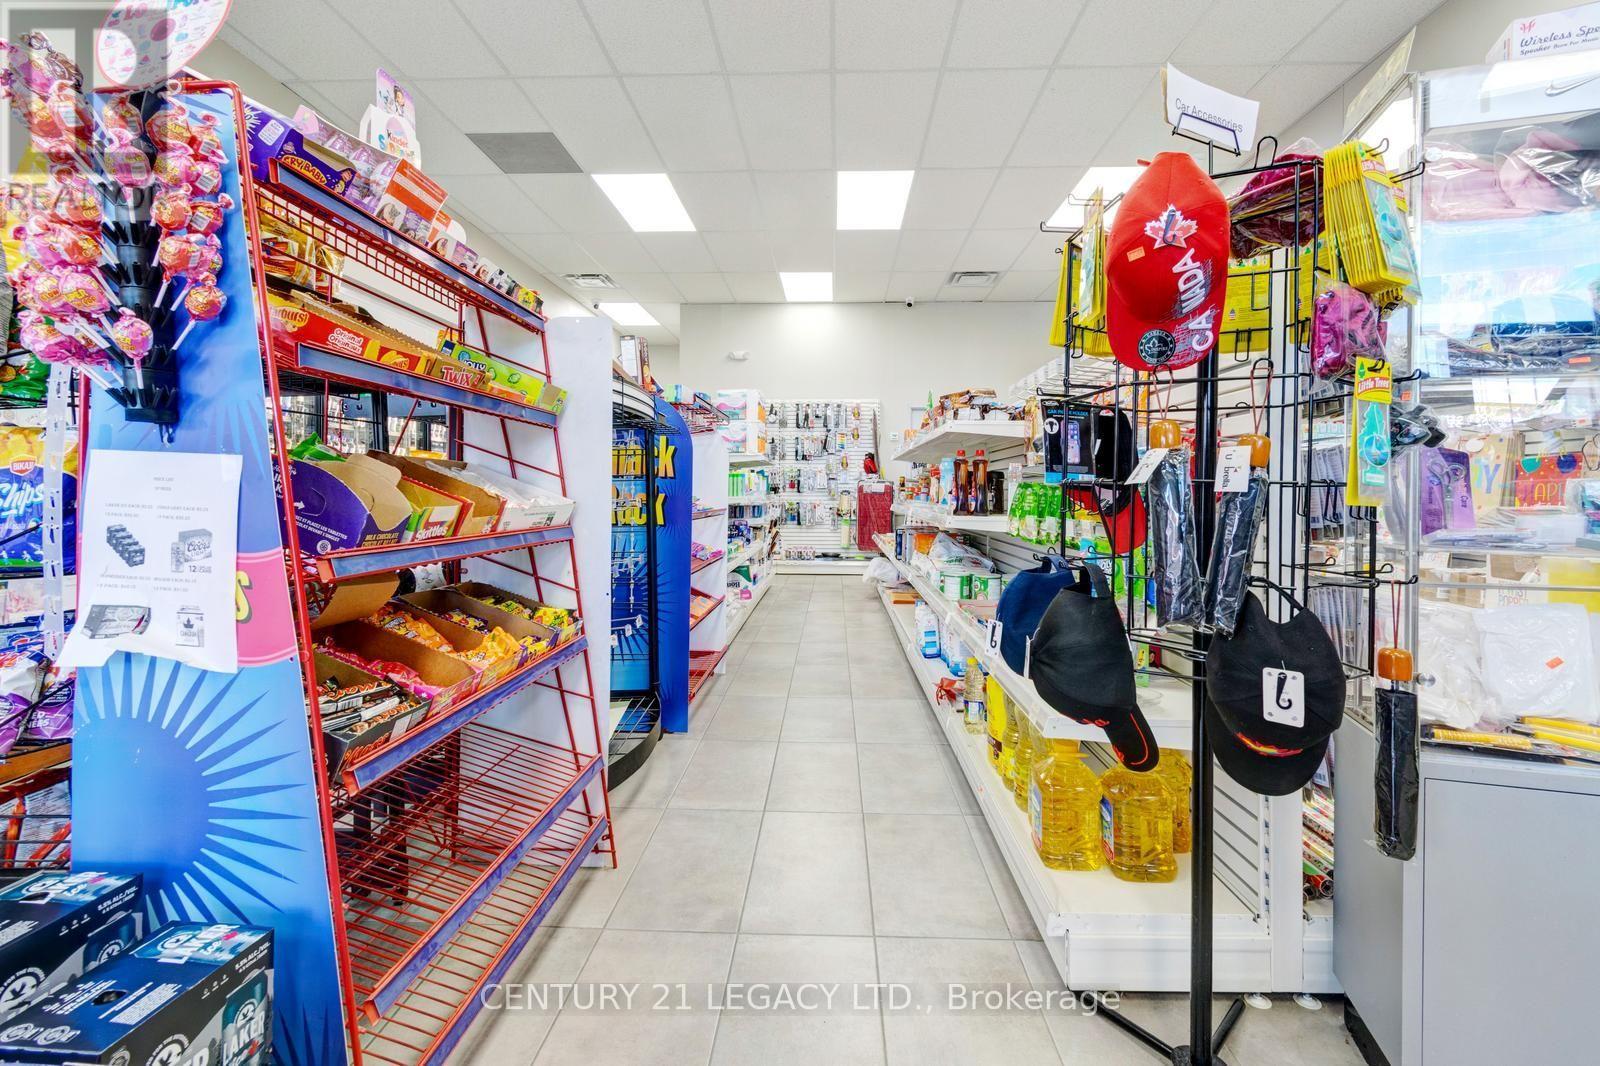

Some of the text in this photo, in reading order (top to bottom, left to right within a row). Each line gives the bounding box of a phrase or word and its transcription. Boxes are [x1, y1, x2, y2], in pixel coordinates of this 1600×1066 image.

[1520, 32, 1572, 48] Wireless
[1175, 98, 1244, 133] Car Accessories
[303, 162, 326, 184] BABY
[335, 328, 364, 345] Original
[1358, 377, 1390, 394] Little Trees
[13, 462, 35, 471] BIKAJI
[376, 532, 399, 540] CHOCOLATE
[416, 525, 449, 541] Skittles
